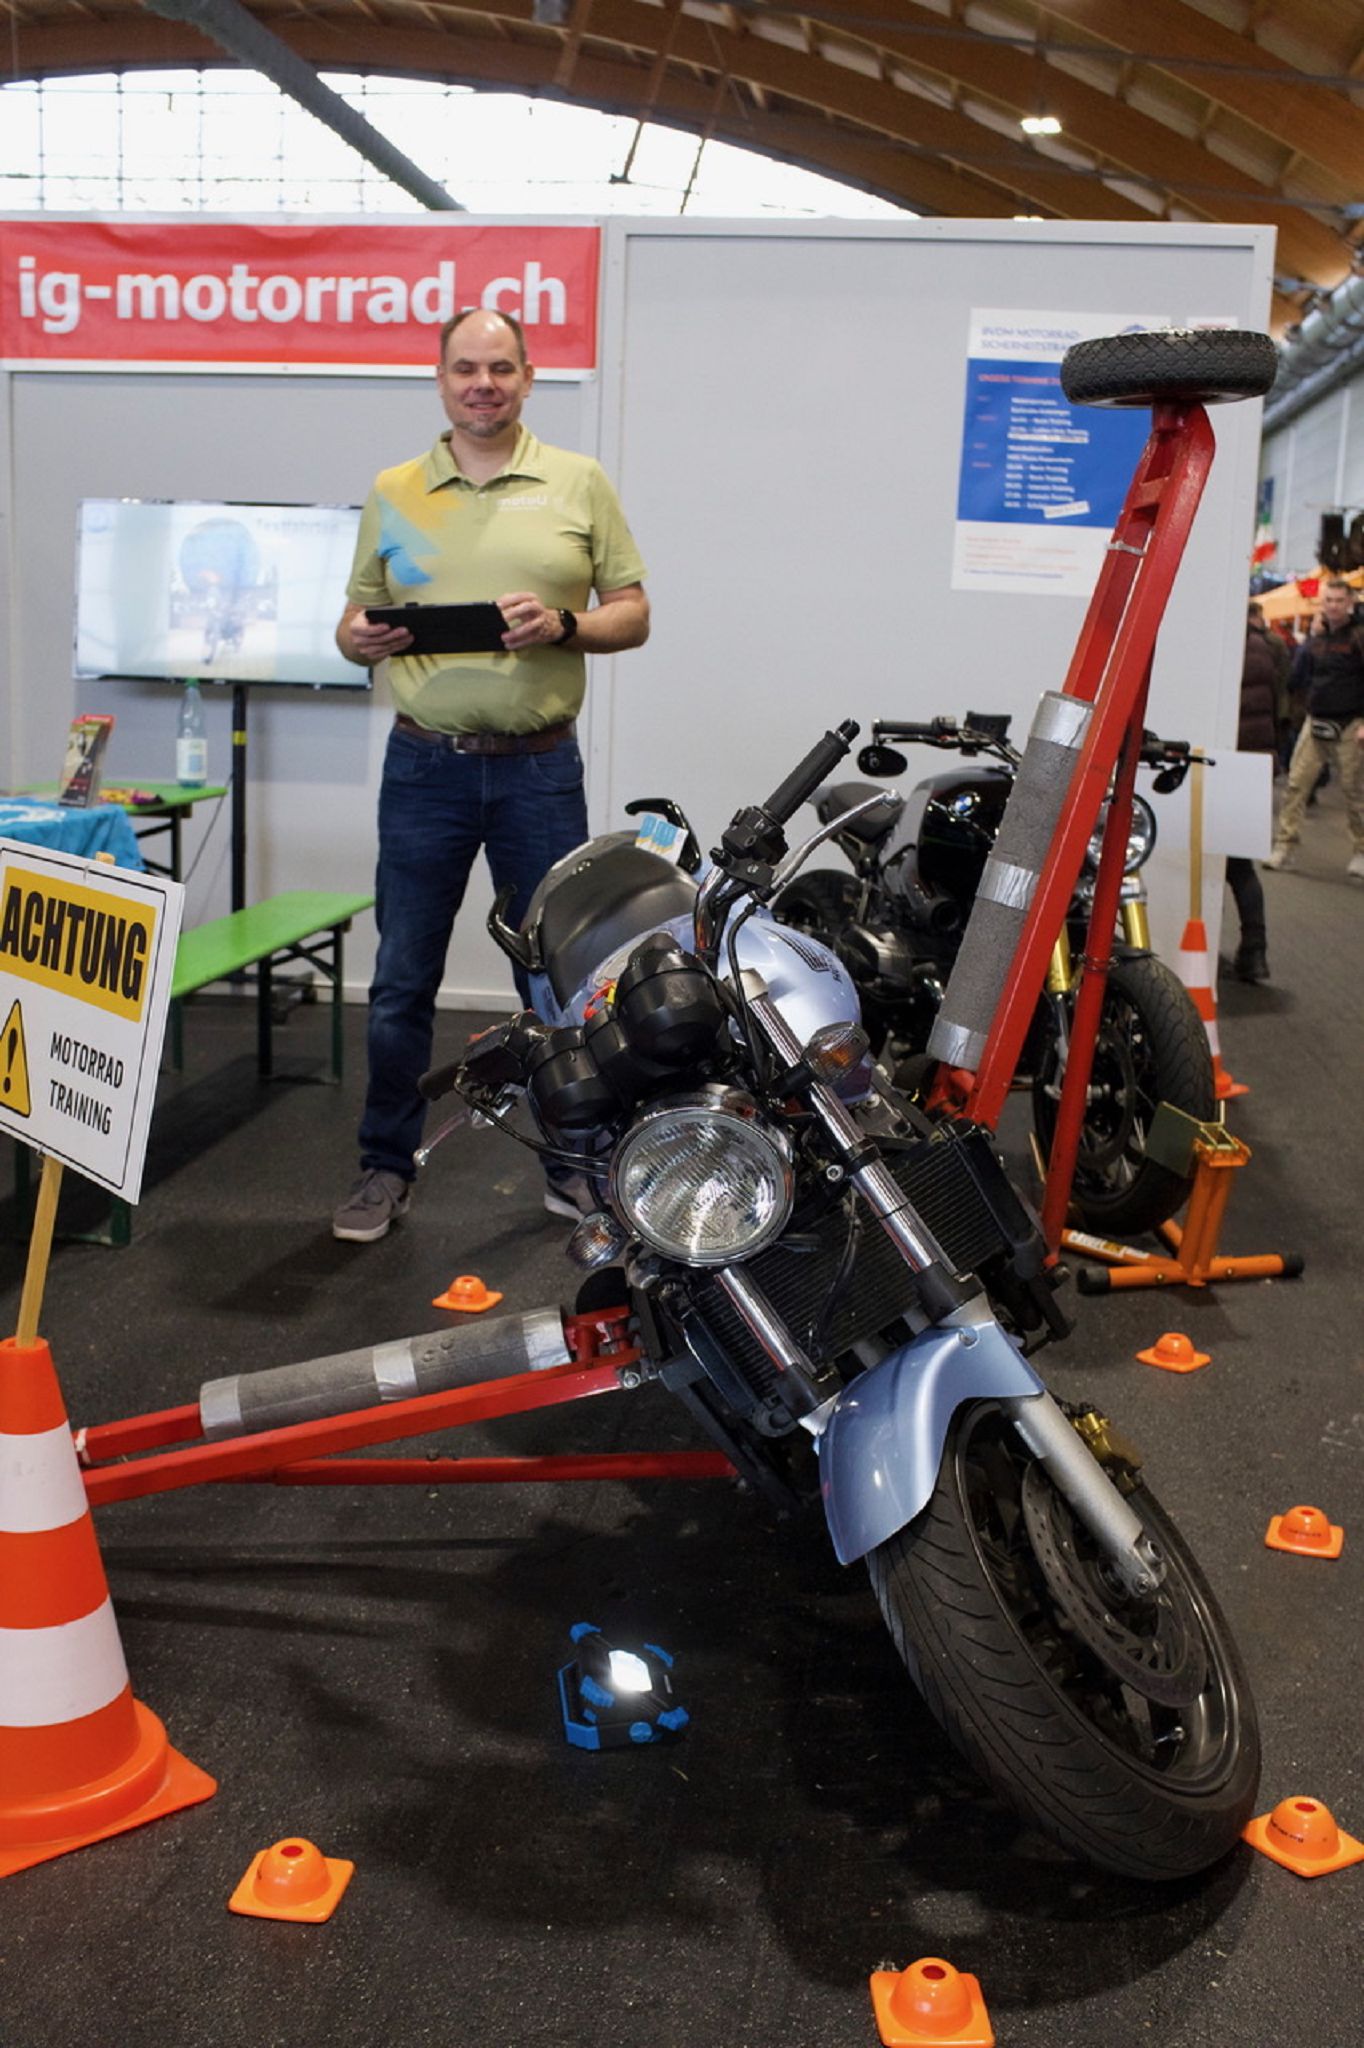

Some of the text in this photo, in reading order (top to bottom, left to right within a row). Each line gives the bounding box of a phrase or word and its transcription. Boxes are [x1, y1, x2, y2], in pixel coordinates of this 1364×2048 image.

[18, 256, 567, 334] ig-motorrad.ch
[0, 885, 148, 1003] ACHTUNG
[50, 1031, 125, 1089] MOTORRAD
[49, 1079, 113, 1136] TRAINING
